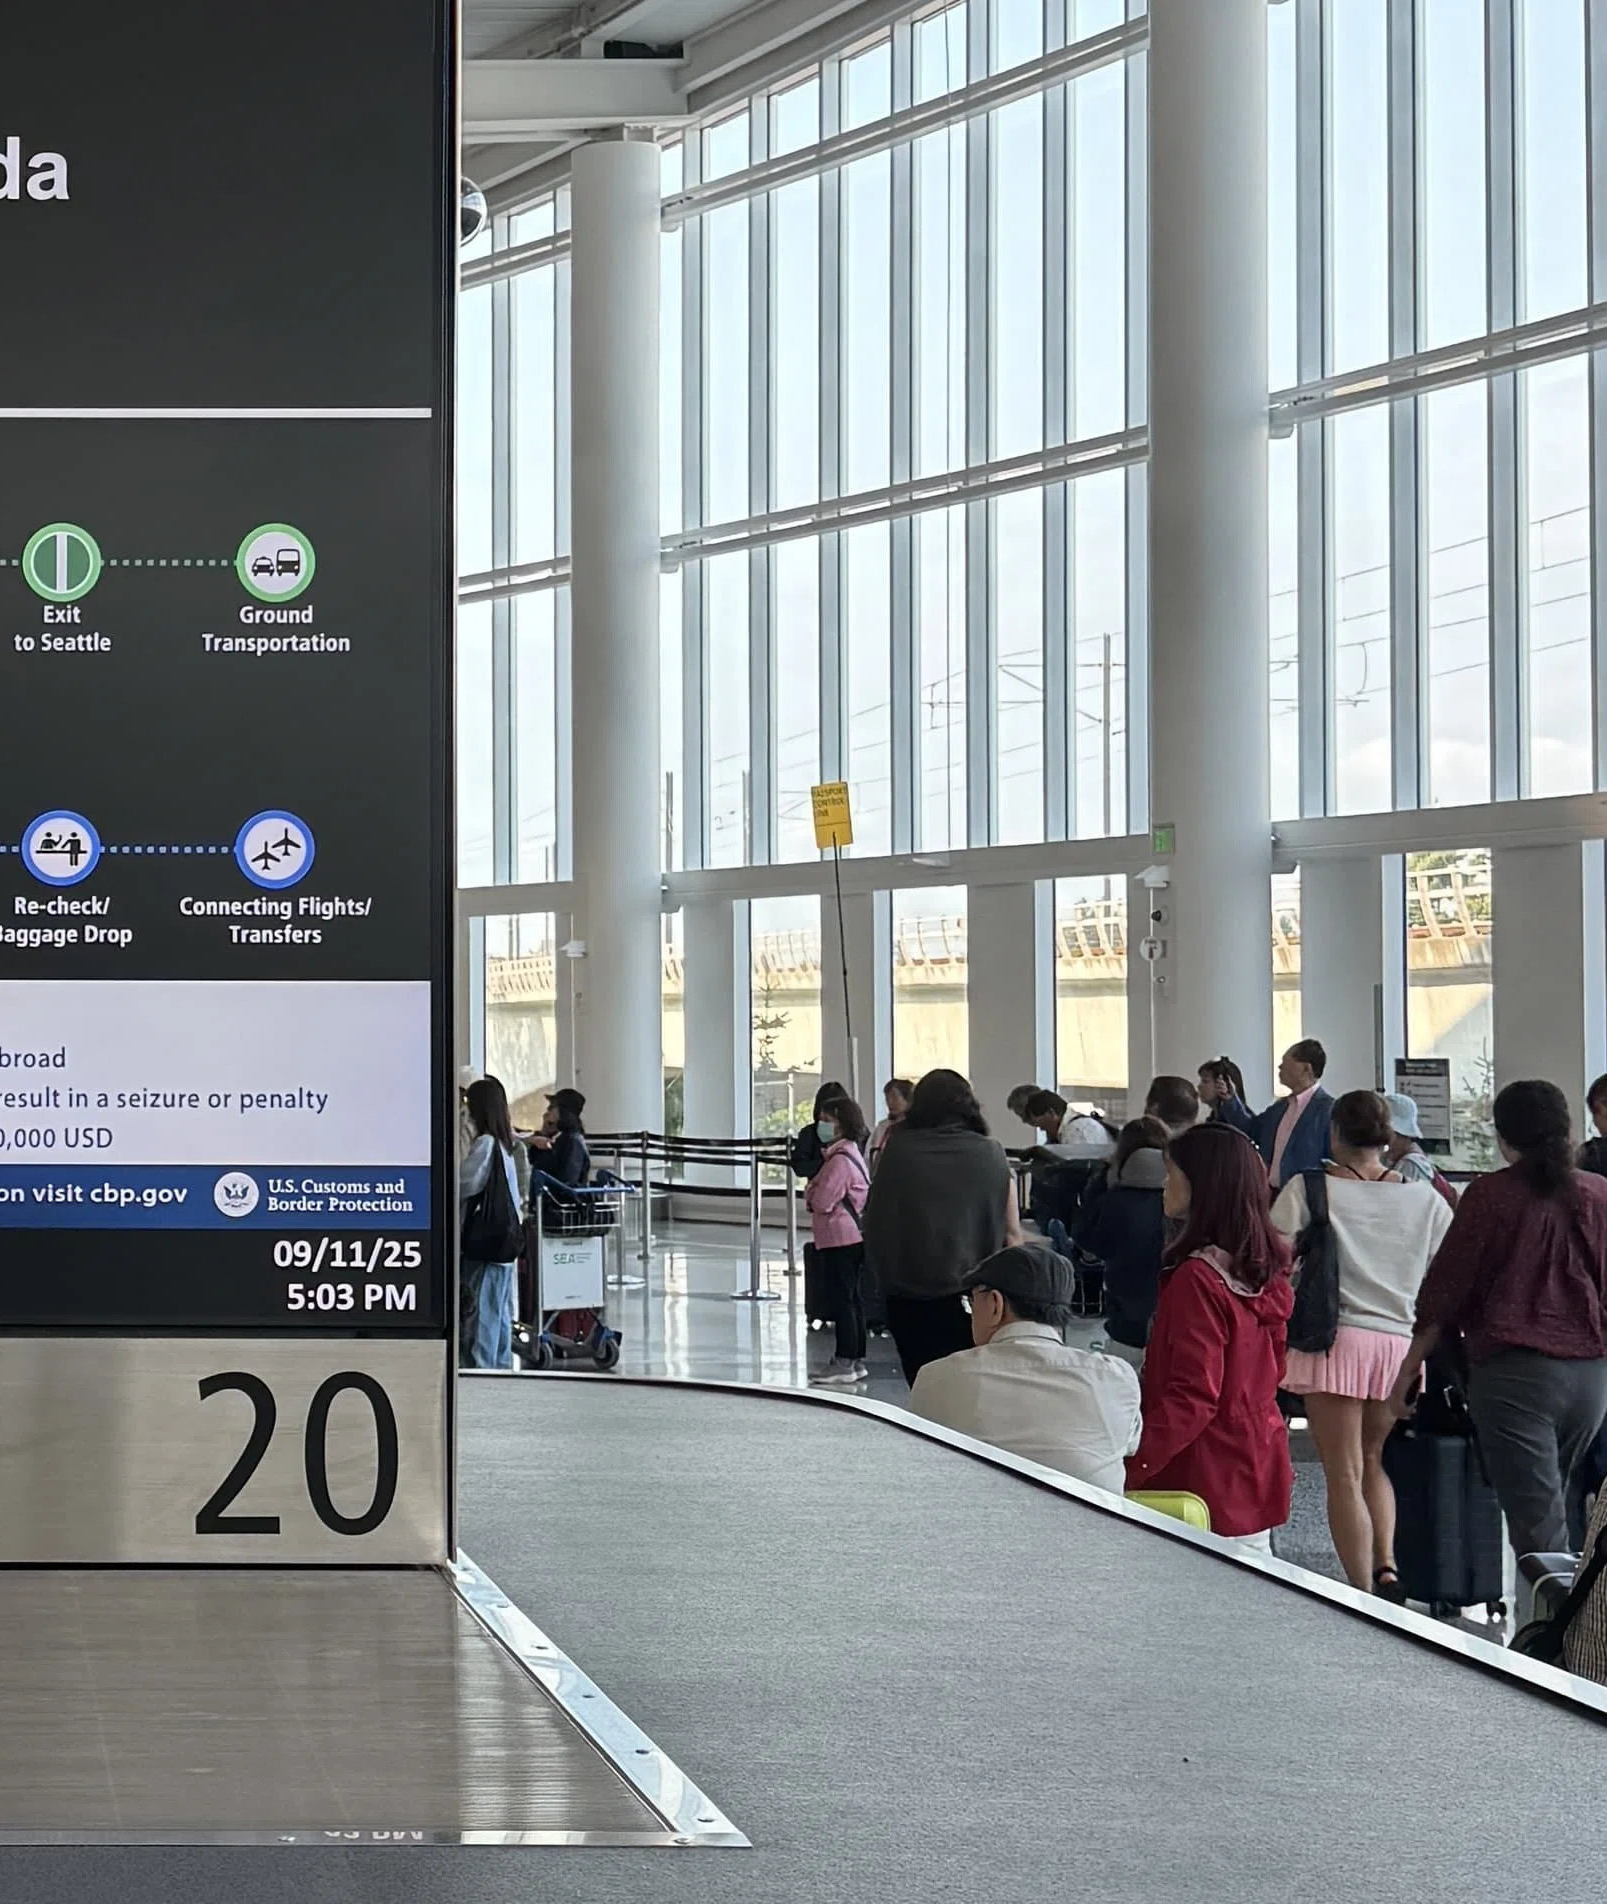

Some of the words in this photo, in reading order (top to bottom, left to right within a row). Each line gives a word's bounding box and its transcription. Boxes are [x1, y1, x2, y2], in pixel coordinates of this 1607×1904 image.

[43, 604, 81, 624] Exit
[239, 604, 313, 624] Ground
[14, 634, 35, 651] to
[41, 631, 112, 652] Seattle
[201, 632, 350, 657] Transportation
[14, 895, 111, 915] Re-check/
[179, 896, 292, 920] Connecting
[298, 896, 372, 921] Flights/
[84, 924, 133, 948] Drop
[228, 923, 322, 944] Transfers
[68, 1087, 88, 1108] in
[96, 1092, 109, 1108] a
[117, 1087, 200, 1109] seizure
[208, 1093, 232, 1109] or
[240, 1086, 329, 1115] penalty
[64, 1127, 113, 1149] USD
[32, 1183, 83, 1202] visit
[90, 1182, 188, 1207] cbp.gov
[268, 1179, 299, 1194] U.S.
[301, 1179, 371, 1194] Customs
[375, 1178, 405, 1194] and
[267, 1195, 324, 1212] Border
[328, 1196, 414, 1212] Protection
[273, 1236, 422, 1273] 09/11/25
[287, 1283, 355, 1311] 5:03
[364, 1283, 416, 1311] PM
[195, 1371, 399, 1536] 20
